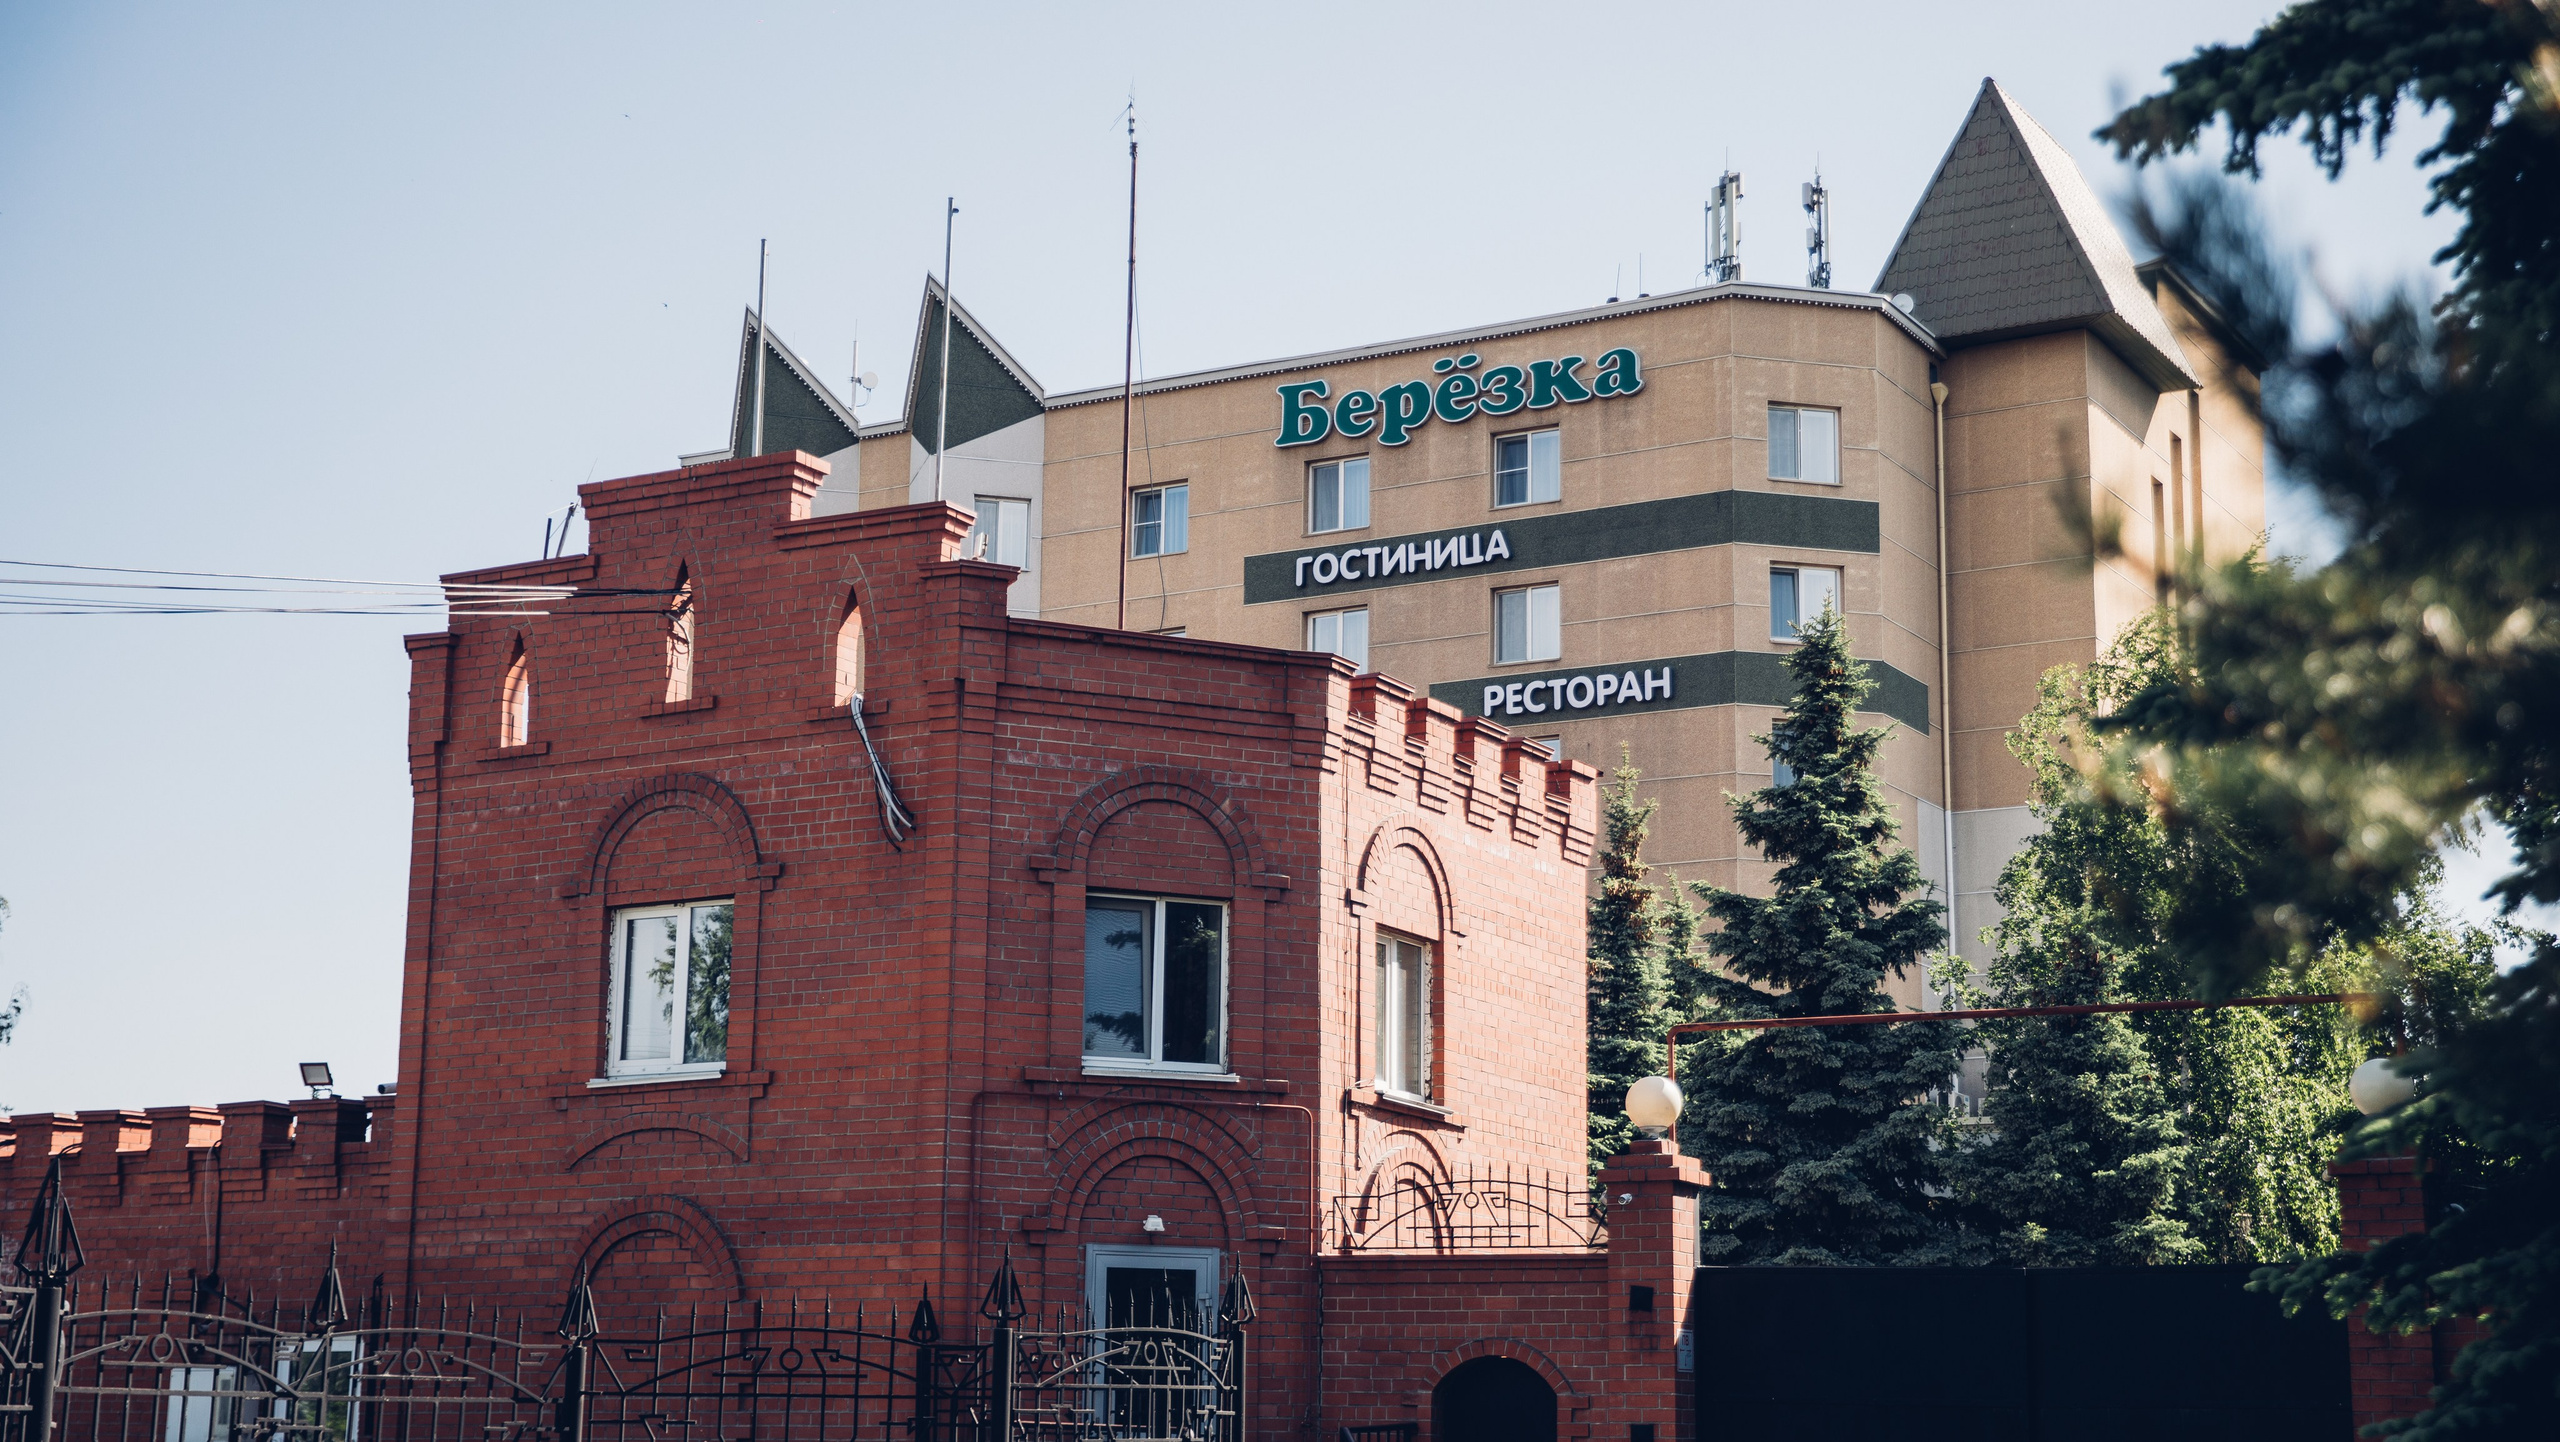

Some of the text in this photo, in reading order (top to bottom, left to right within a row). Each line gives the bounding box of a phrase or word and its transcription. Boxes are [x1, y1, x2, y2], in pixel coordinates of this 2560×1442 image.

[1274, 348, 1644, 447] Берёзка
[1296, 530, 1510, 586] ГОСТИНИЦА
[1484, 667, 1672, 717] РЕСТОРАН
